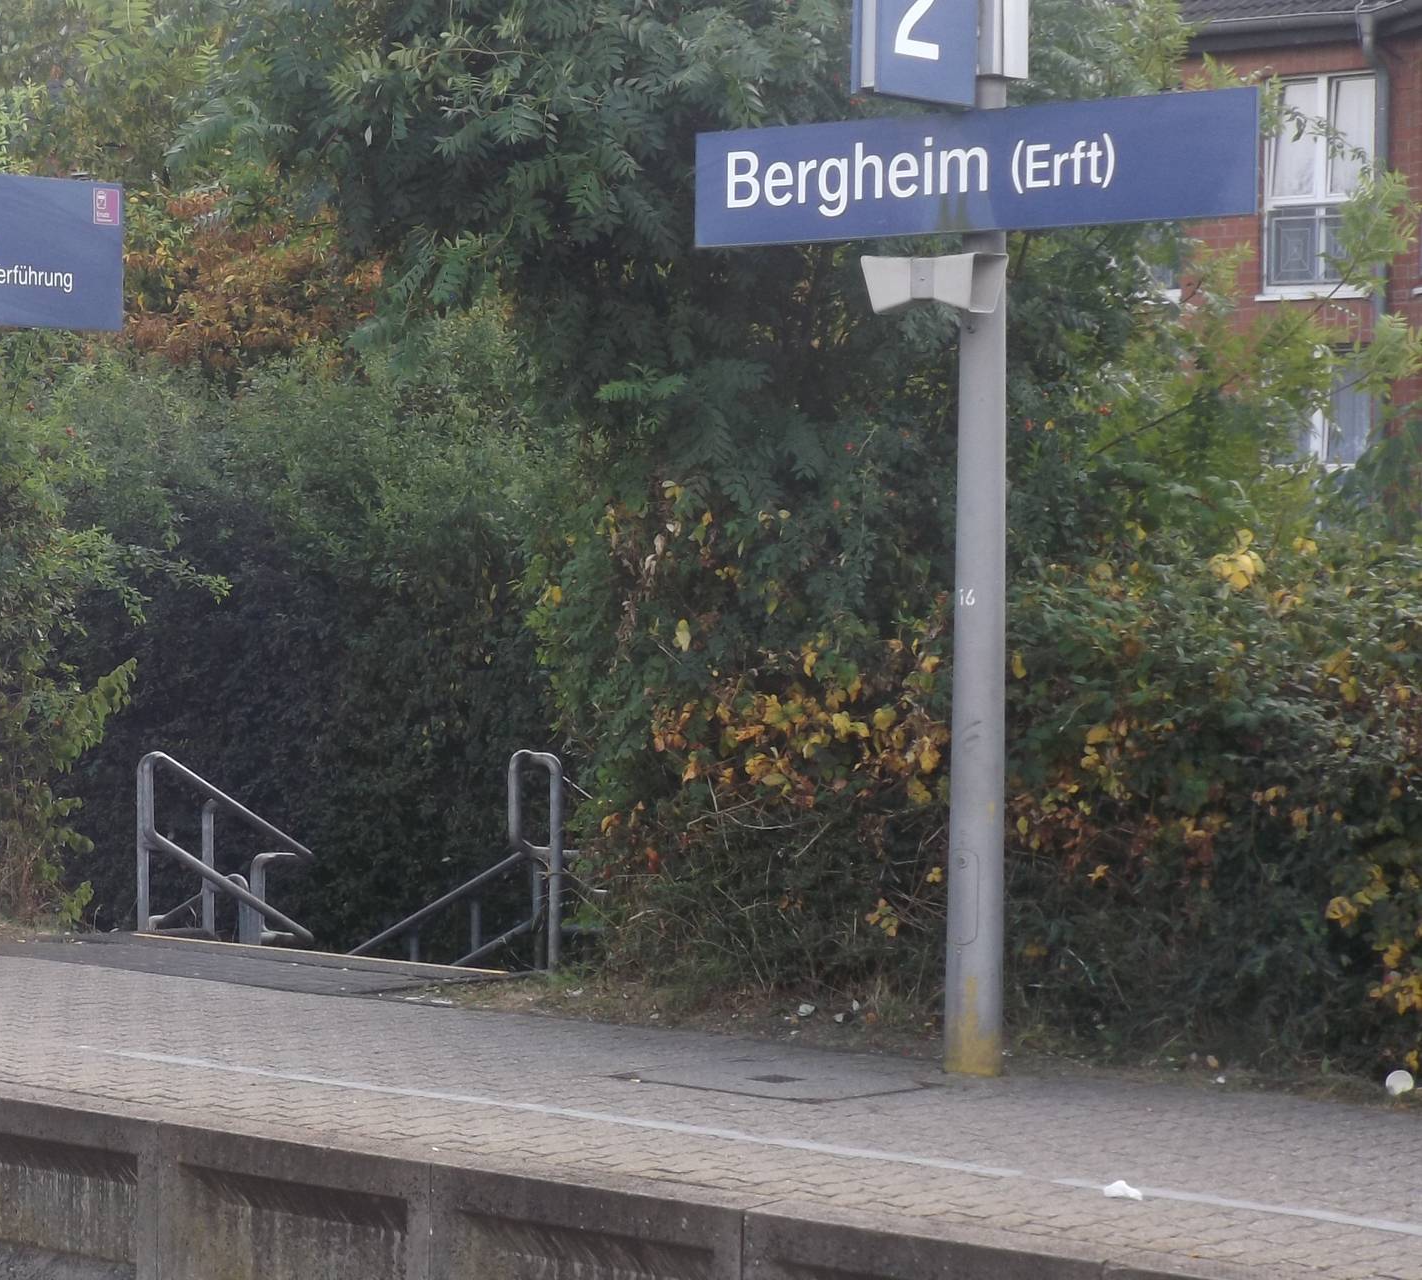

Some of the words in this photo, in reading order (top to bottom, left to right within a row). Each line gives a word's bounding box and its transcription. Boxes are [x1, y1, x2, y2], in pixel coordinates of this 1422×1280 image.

[894, 0, 939, 61] 2
[727, 137, 989, 217] Bergheim
[1011, 133, 1115, 194] (Erft)
